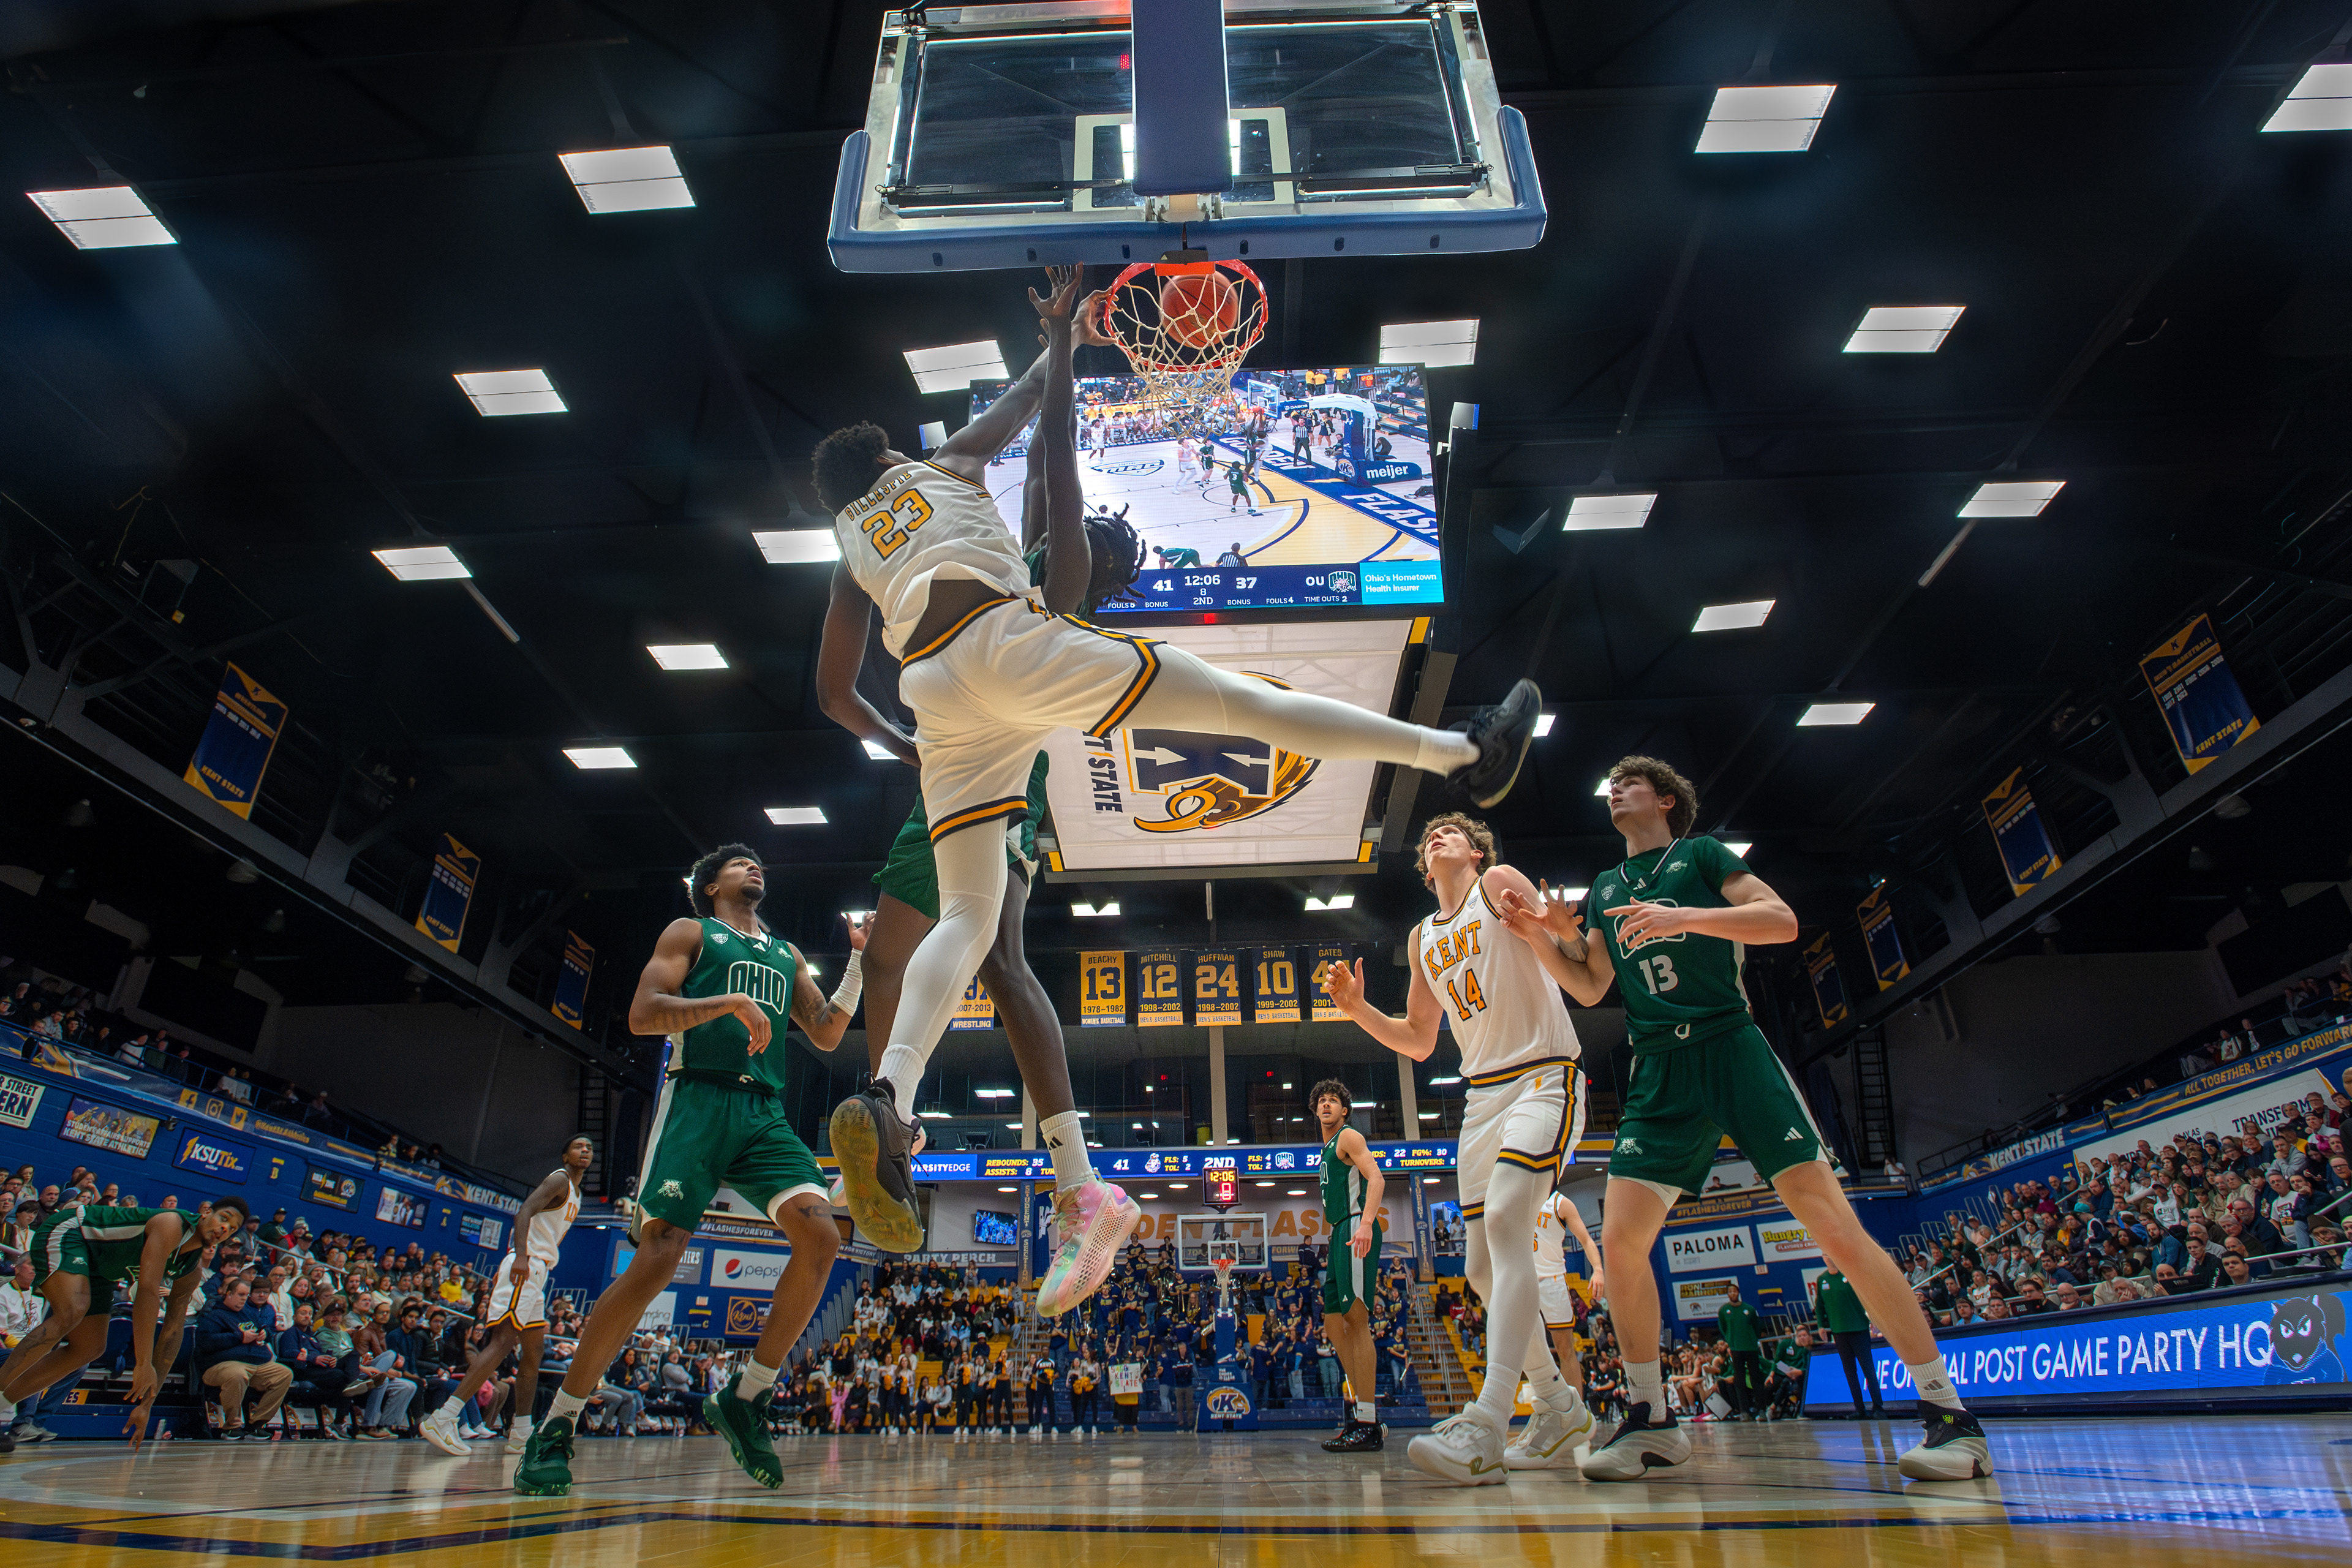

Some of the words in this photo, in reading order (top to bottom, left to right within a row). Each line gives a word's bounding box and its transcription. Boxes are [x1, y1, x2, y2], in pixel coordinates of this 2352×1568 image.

[1366, 464, 1408, 479] meijer
[845, 471, 912, 521] GILLESPIE
[861, 488, 934, 561] 23
[1153, 579, 1174, 591] 41
[1185, 575, 1220, 586] 12:06
[1235, 577, 1257, 589] 37
[1306, 576, 1324, 586] OU
[1328, 571, 1356, 589] OHIO
[1365, 584, 1391, 593] Health
[1193, 597, 1214, 605] 2ND
[2196, 735, 2217, 754] KENT
[2215, 718, 2243, 741] STATE
[1087, 757, 1123, 813] STATE
[1141, 954, 1177, 964] MITCHELL
[1198, 954, 1235, 963] HUFFMAN
[1263, 951, 1285, 959] SHAW
[1424, 920, 1481, 982] KENT
[1086, 967, 1121, 1000] 13
[1142, 964, 1178, 998] 12
[1196, 964, 1239, 997] 24
[1257, 961, 1295, 995] 10
[1311, 960, 1350, 993] 4
[1638, 955, 1678, 995] 13
[728, 960, 786, 1015] OHIO
[1447, 968, 1487, 1021] 14
[2185, 1082, 2202, 1096] ALL
[2201, 1063, 2255, 1089] TOGETHER,
[2255, 1052, 2283, 1071] LET'S
[2284, 1044, 2300, 1059] GO
[2301, 1025, 2352, 1053] FORWAR
[6, 1079, 39, 1096] STREET
[0, 1090, 34, 1117] ERN
[63, 1127, 86, 1140] KENT
[85, 1133, 110, 1147] STATE
[108, 1140, 148, 1158] ATHLETICS
[67, 1120, 95, 1133] STUDENT
[121, 1134, 151, 1149] SUPPORTS
[1394, 1149, 1406, 1157] 22
[1990, 1142, 2022, 1169] KENT
[2024, 1128, 2065, 1155] STATE
[911, 1163, 970, 1173] VERSITYEDGE
[1113, 1159, 1130, 1170] 41
[1204, 1157, 1235, 1168] 2ND
[1306, 1155, 1321, 1166] 37
[1385, 1159, 1392, 1167] 6
[1400, 1158, 1445, 1167] TURNOVERS:
[1210, 1171, 1234, 1182] 12:06
[465, 1183, 495, 1204] KENT
[497, 1195, 523, 1214] STAT
[1677, 1200, 1752, 1217] #FLASHESFOREVER
[1132, 1213, 1204, 1240] DEN
[1232, 1207, 1389, 1240] FLASS
[1537, 1212, 1552, 1229] NT
[701, 1223, 774, 1237] #FLASHESFOREVER
[1762, 1229, 1804, 1243] Hungry
[1673, 1234, 1744, 1256] PALOMA
[904, 1254, 948, 1263] PARTY
[951, 1254, 996, 1263] PERCH
[745, 1265, 781, 1279] pepsi
[703, 1320, 709, 1329] C
[1974, 1346, 2027, 1384] POST
[2032, 1337, 2108, 1380] GAME
[2118, 1326, 2208, 1374] PARTY
[2218, 1321, 2273, 1368] HQ
[1115, 1379, 1138, 1387] STATE
[1216, 1393, 1238, 1413] K
